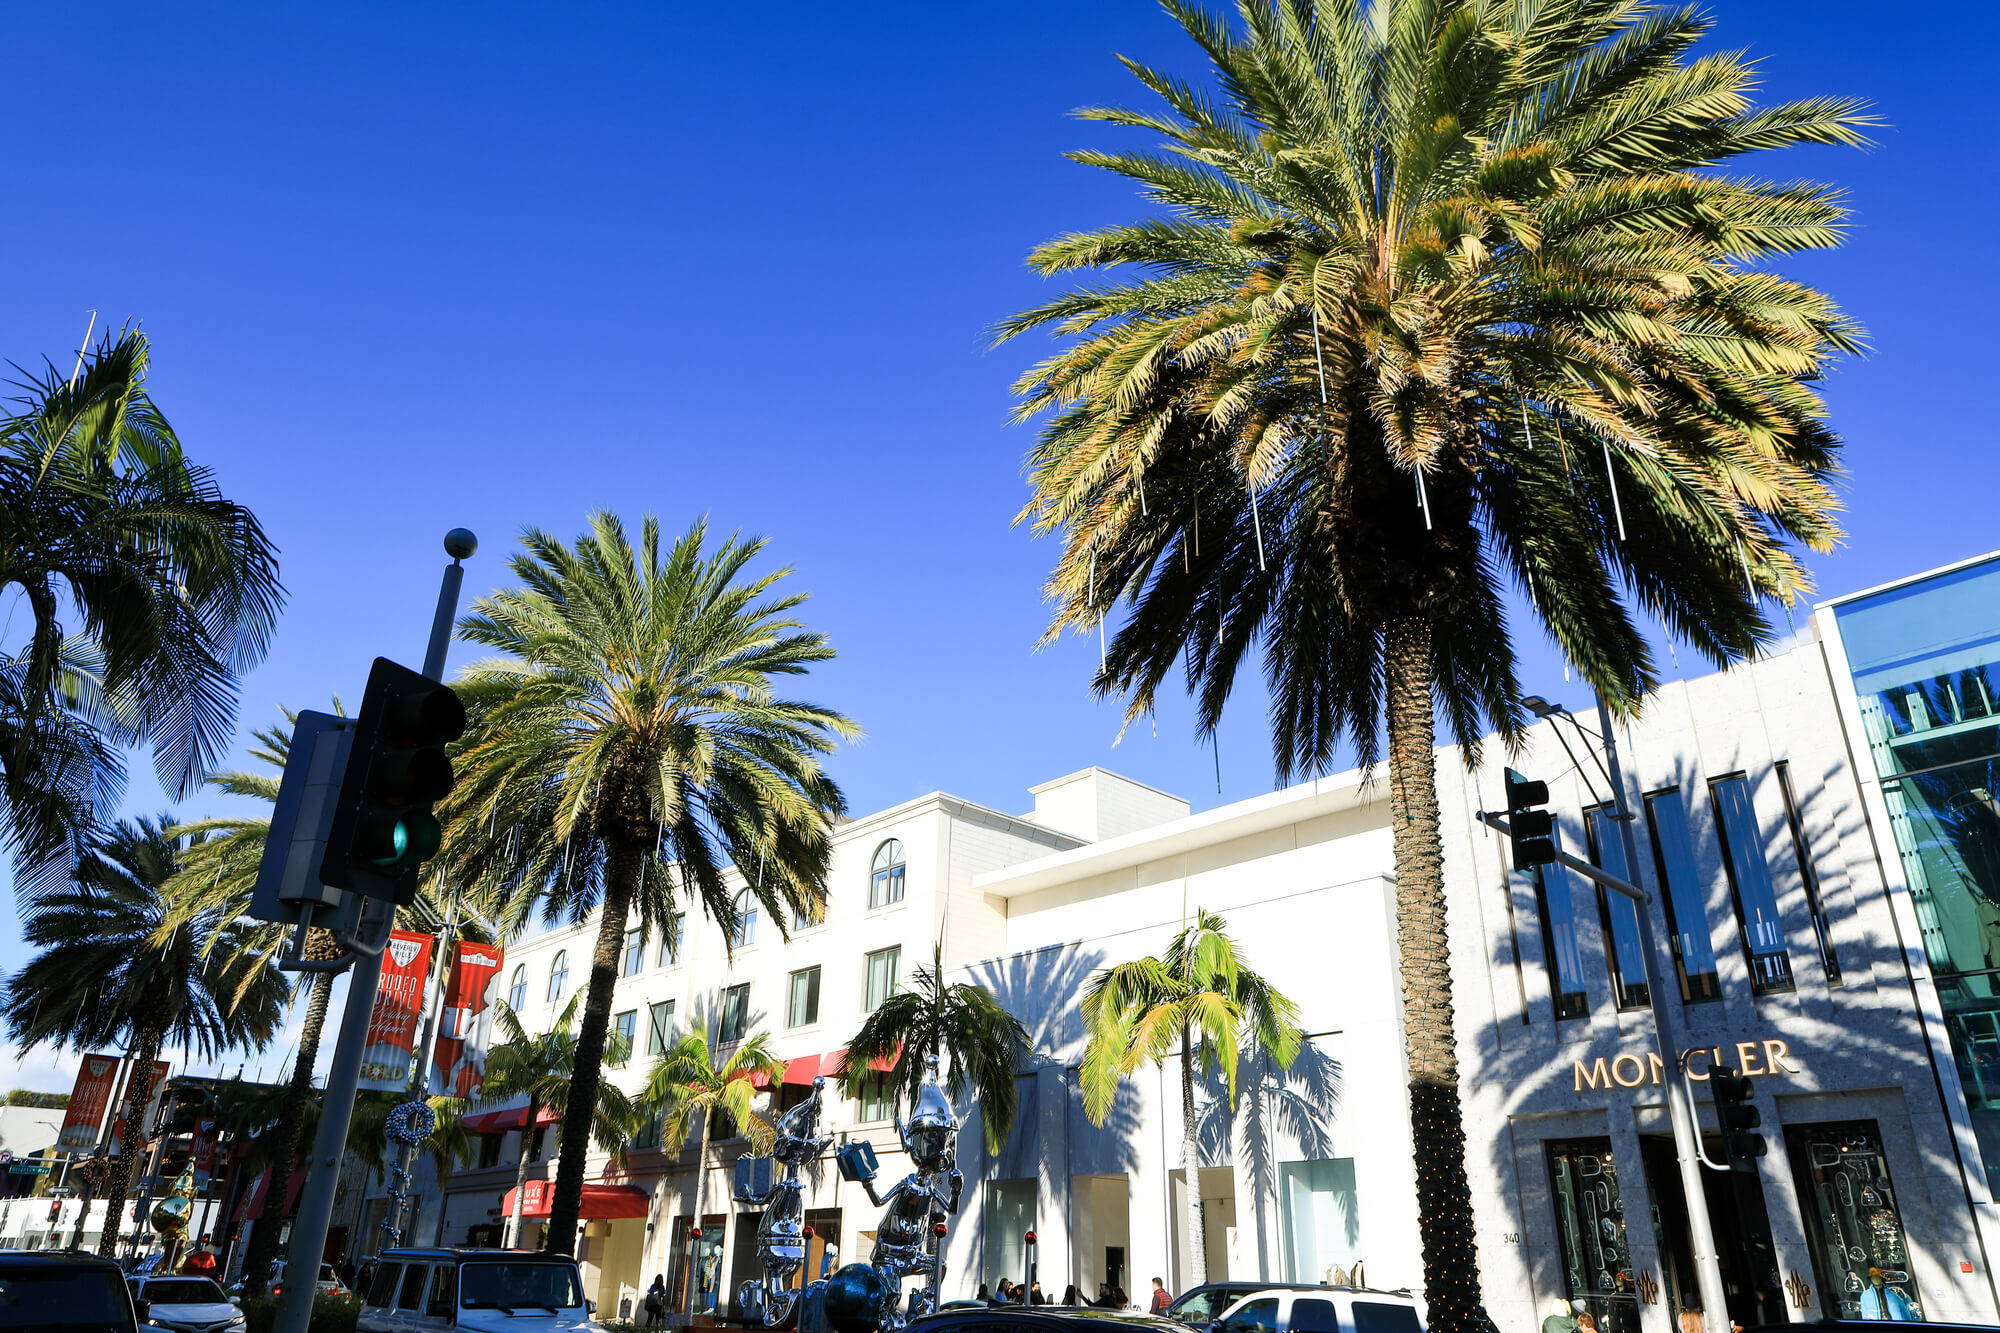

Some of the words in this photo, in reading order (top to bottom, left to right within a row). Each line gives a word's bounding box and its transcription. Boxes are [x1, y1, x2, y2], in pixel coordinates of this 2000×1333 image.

[395, 950, 412, 959] HILLS
[377, 972, 417, 993] RODEO
[374, 988, 415, 1010] DRIVE
[1503, 1232, 1520, 1244] 340
